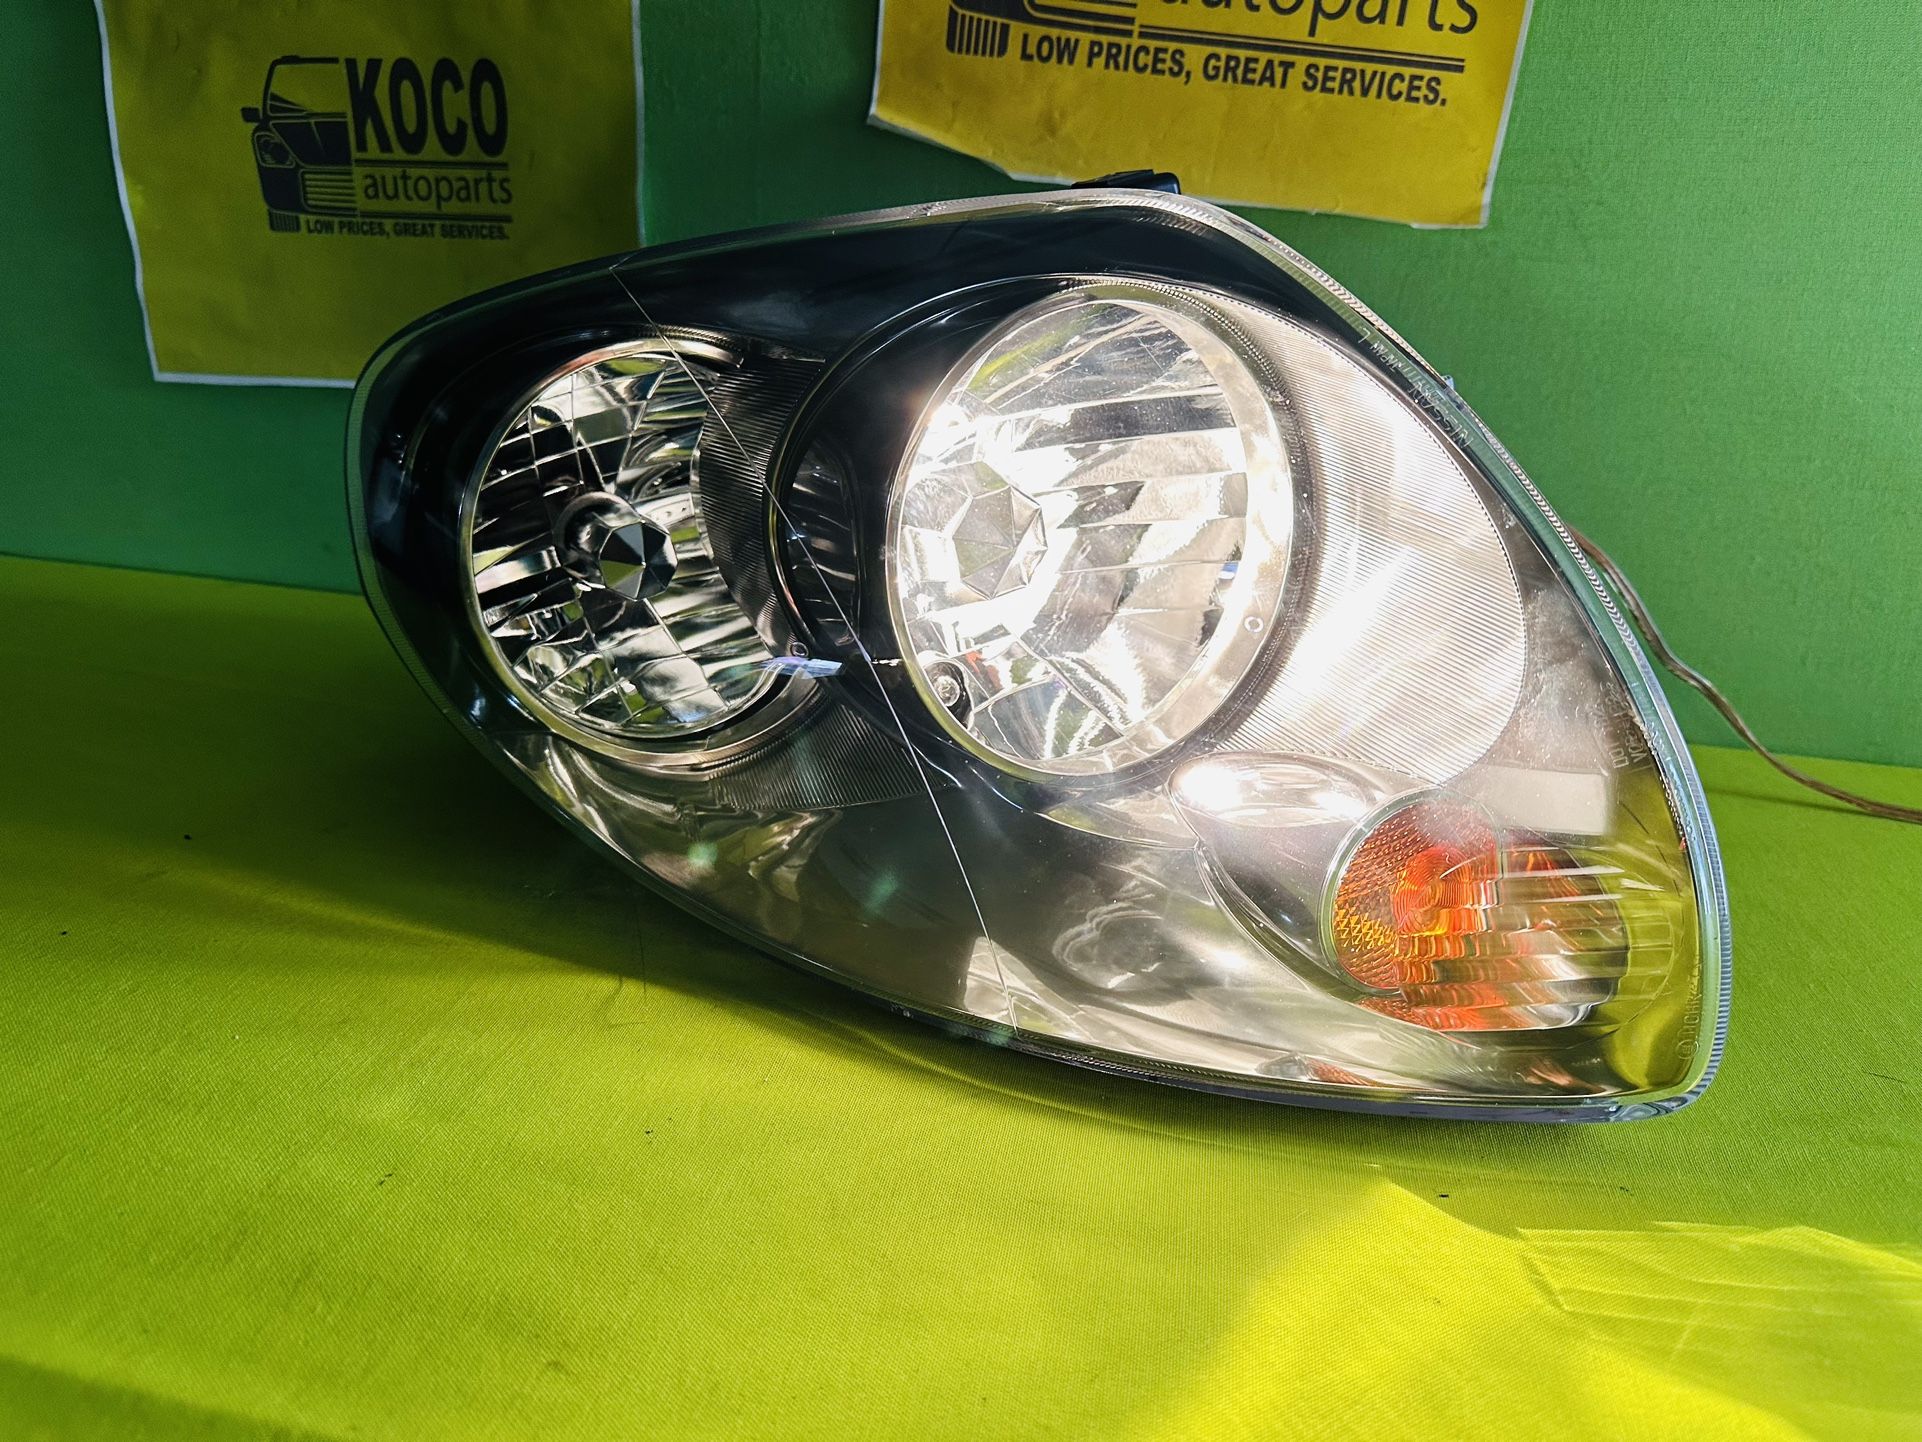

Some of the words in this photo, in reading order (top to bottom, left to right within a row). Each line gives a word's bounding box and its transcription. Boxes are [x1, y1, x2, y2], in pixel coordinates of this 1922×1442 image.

[1020, 32, 1080, 66] LOW
[1086, 40, 1192, 85] PRICES,
[1202, 52, 1295, 90] GREAT
[1301, 63, 1448, 107] SERVICES.
[344, 57, 508, 157] KOCO
[363, 168, 513, 211] autoparts
[305, 218, 335, 234] LOW
[337, 219, 390, 239] PRICES,
[393, 221, 435, 238] GREAT
[440, 223, 510, 240] SERVICES.
[1408, 382, 1474, 448] NISSAN
